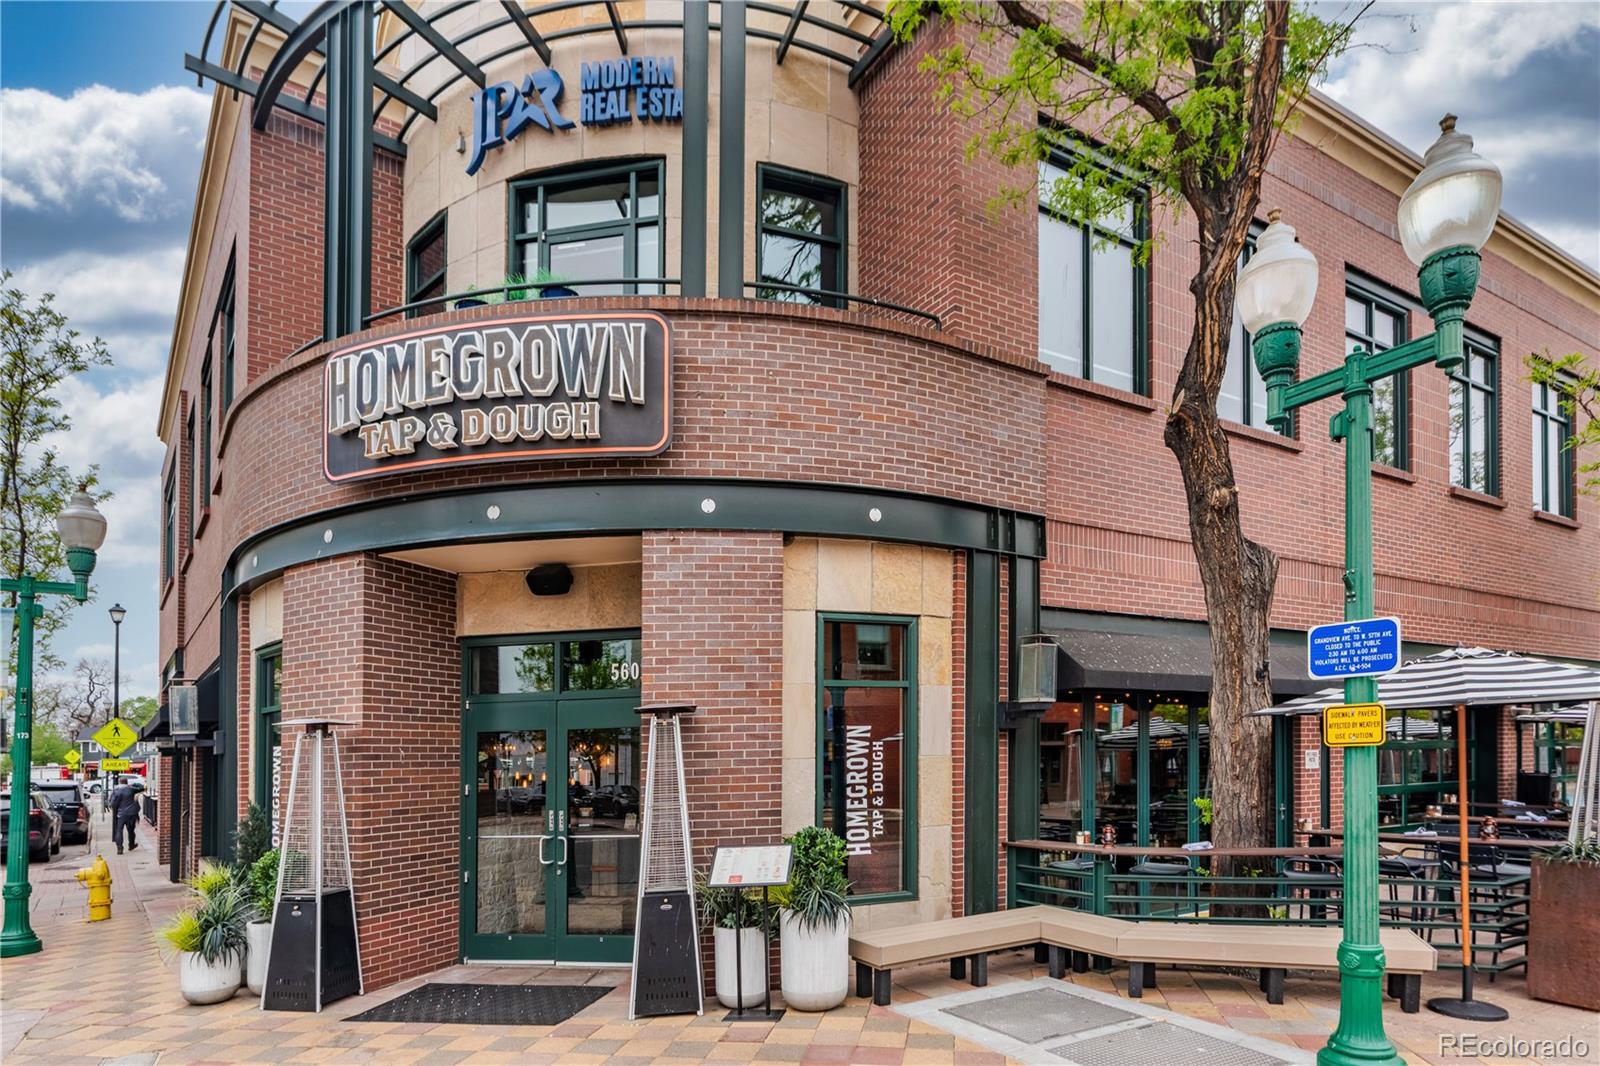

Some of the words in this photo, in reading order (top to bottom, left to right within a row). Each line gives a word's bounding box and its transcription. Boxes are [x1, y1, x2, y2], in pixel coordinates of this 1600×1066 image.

[580, 56, 674, 91] MODERN
[580, 89, 632, 124] REAL
[636, 86, 683, 121] ESTA
[328, 322, 646, 436] HOMEGROWN
[358, 415, 427, 459] TAP
[427, 411, 458, 449] &
[461, 401, 601, 446] DOUGH
[1314, 636, 1341, 645] GRANDVIEW
[1324, 643, 1343, 651] CLOSED
[1363, 639, 1381, 647] PUBLIC
[611, 662, 640, 680] 560
[1314, 657, 1339, 666] VIOLATORS
[1361, 653, 1393, 662] PROSECUTED
[1328, 721, 1351, 729] AFFECTED
[1330, 711, 1355, 719] SIDEWALK
[1357, 709, 1378, 717] PAVERS
[1348, 731, 1374, 739] CAUTION
[872, 741, 884, 792] DOUGH
[272, 745, 282, 848] OMEGROWN
[846, 725, 872, 856] HOMEGROWN
[872, 795, 884, 806] &
[872, 809, 884, 838] TAP
